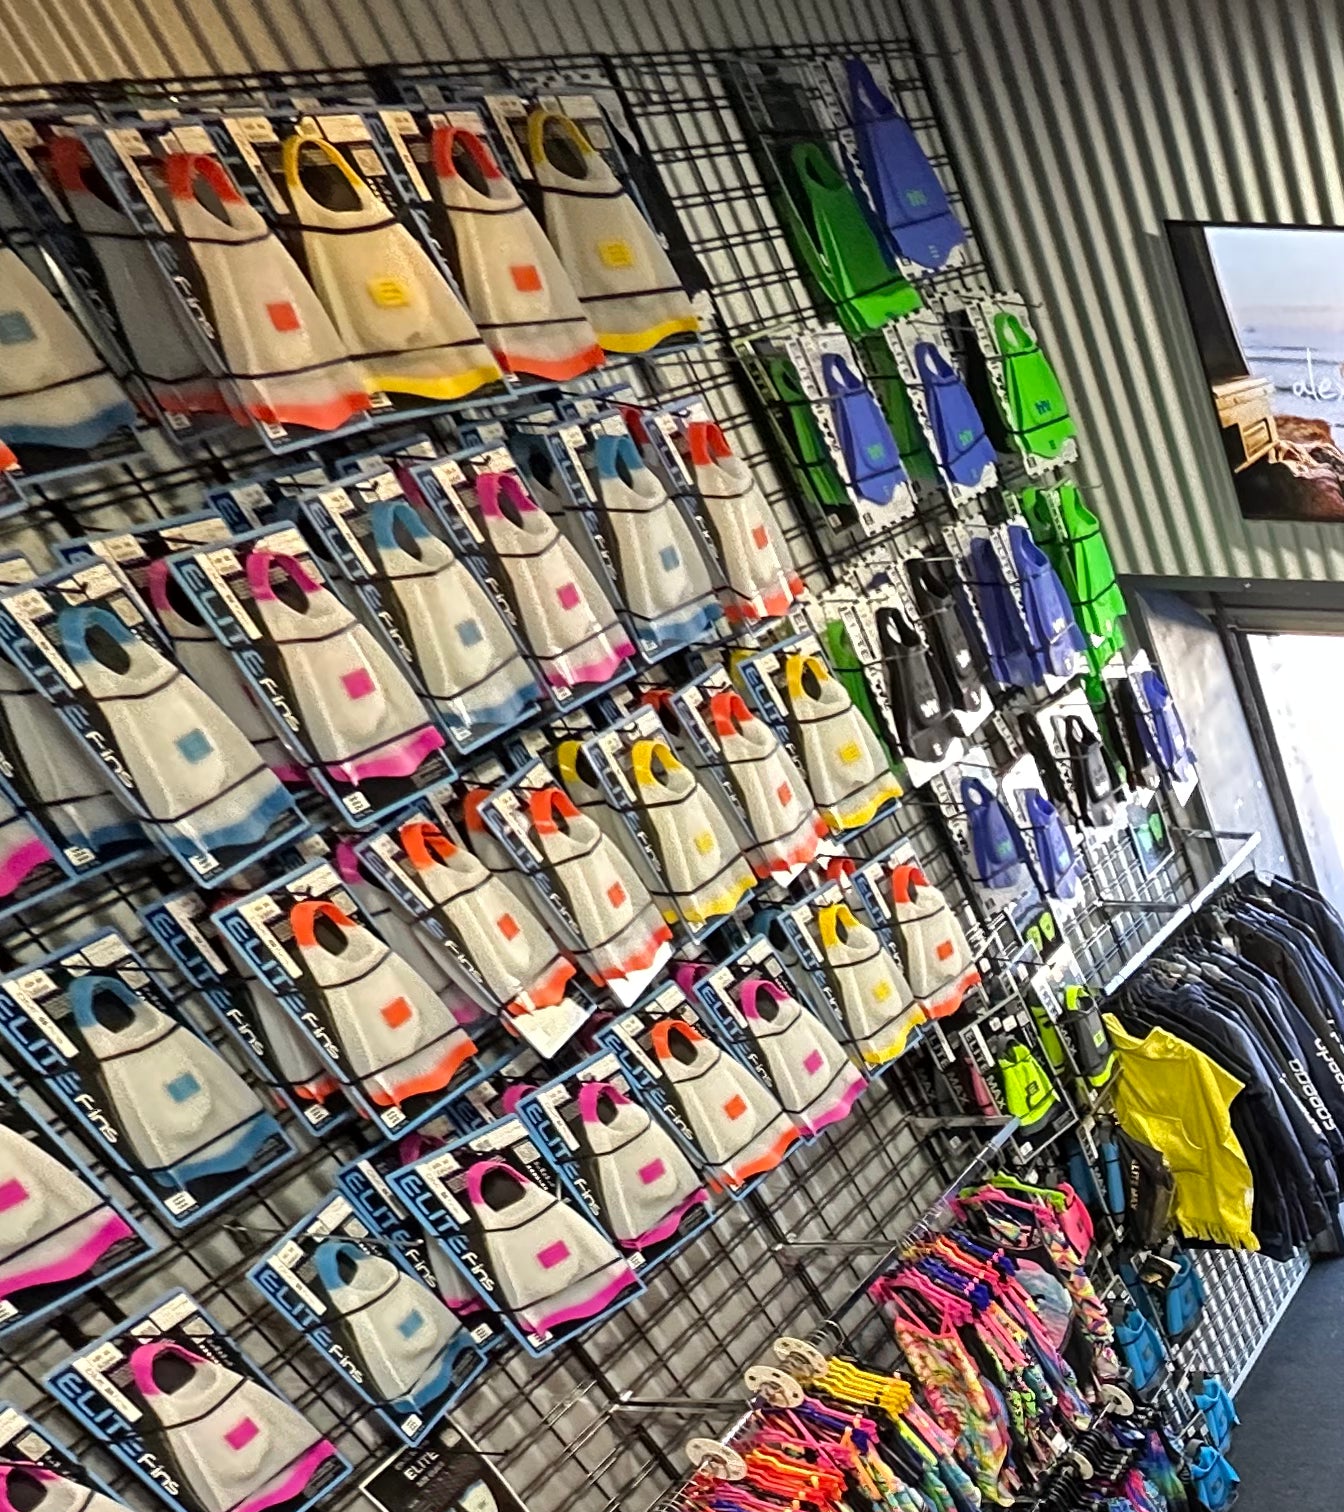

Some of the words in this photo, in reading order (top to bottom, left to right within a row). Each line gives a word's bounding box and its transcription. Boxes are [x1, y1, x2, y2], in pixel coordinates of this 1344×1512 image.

[182, 563, 265, 681] ELITE
[259, 678, 300, 733] Fins
[86, 731, 135, 788] Fins
[151, 913, 230, 1011] ELITE
[226, 1008, 265, 1057] Fins
[227, 916, 307, 1014] ELITE
[301, 1012, 340, 1060] Fins
[703, 985, 751, 1054] ELITE
[74, 1094, 119, 1144] Fins
[604, 1034, 666, 1103] ELITE
[663, 1105, 694, 1141] Fins
[964, 1030, 988, 1077] ELITE
[987, 1075, 1006, 1109] MAX
[526, 1103, 582, 1180] ELITE
[574, 1178, 601, 1217] Fins
[346, 1171, 412, 1250] ELITE
[405, 1249, 437, 1288] Fins
[401, 1175, 470, 1253] ELITE
[461, 1251, 496, 1292] Fins
[258, 1270, 334, 1347] ELITE
[328, 1343, 364, 1384] Fins
[55, 1371, 144, 1457] ELITE
[137, 1452, 180, 1496] Fins
[403, 1452, 440, 1481] ELITE
